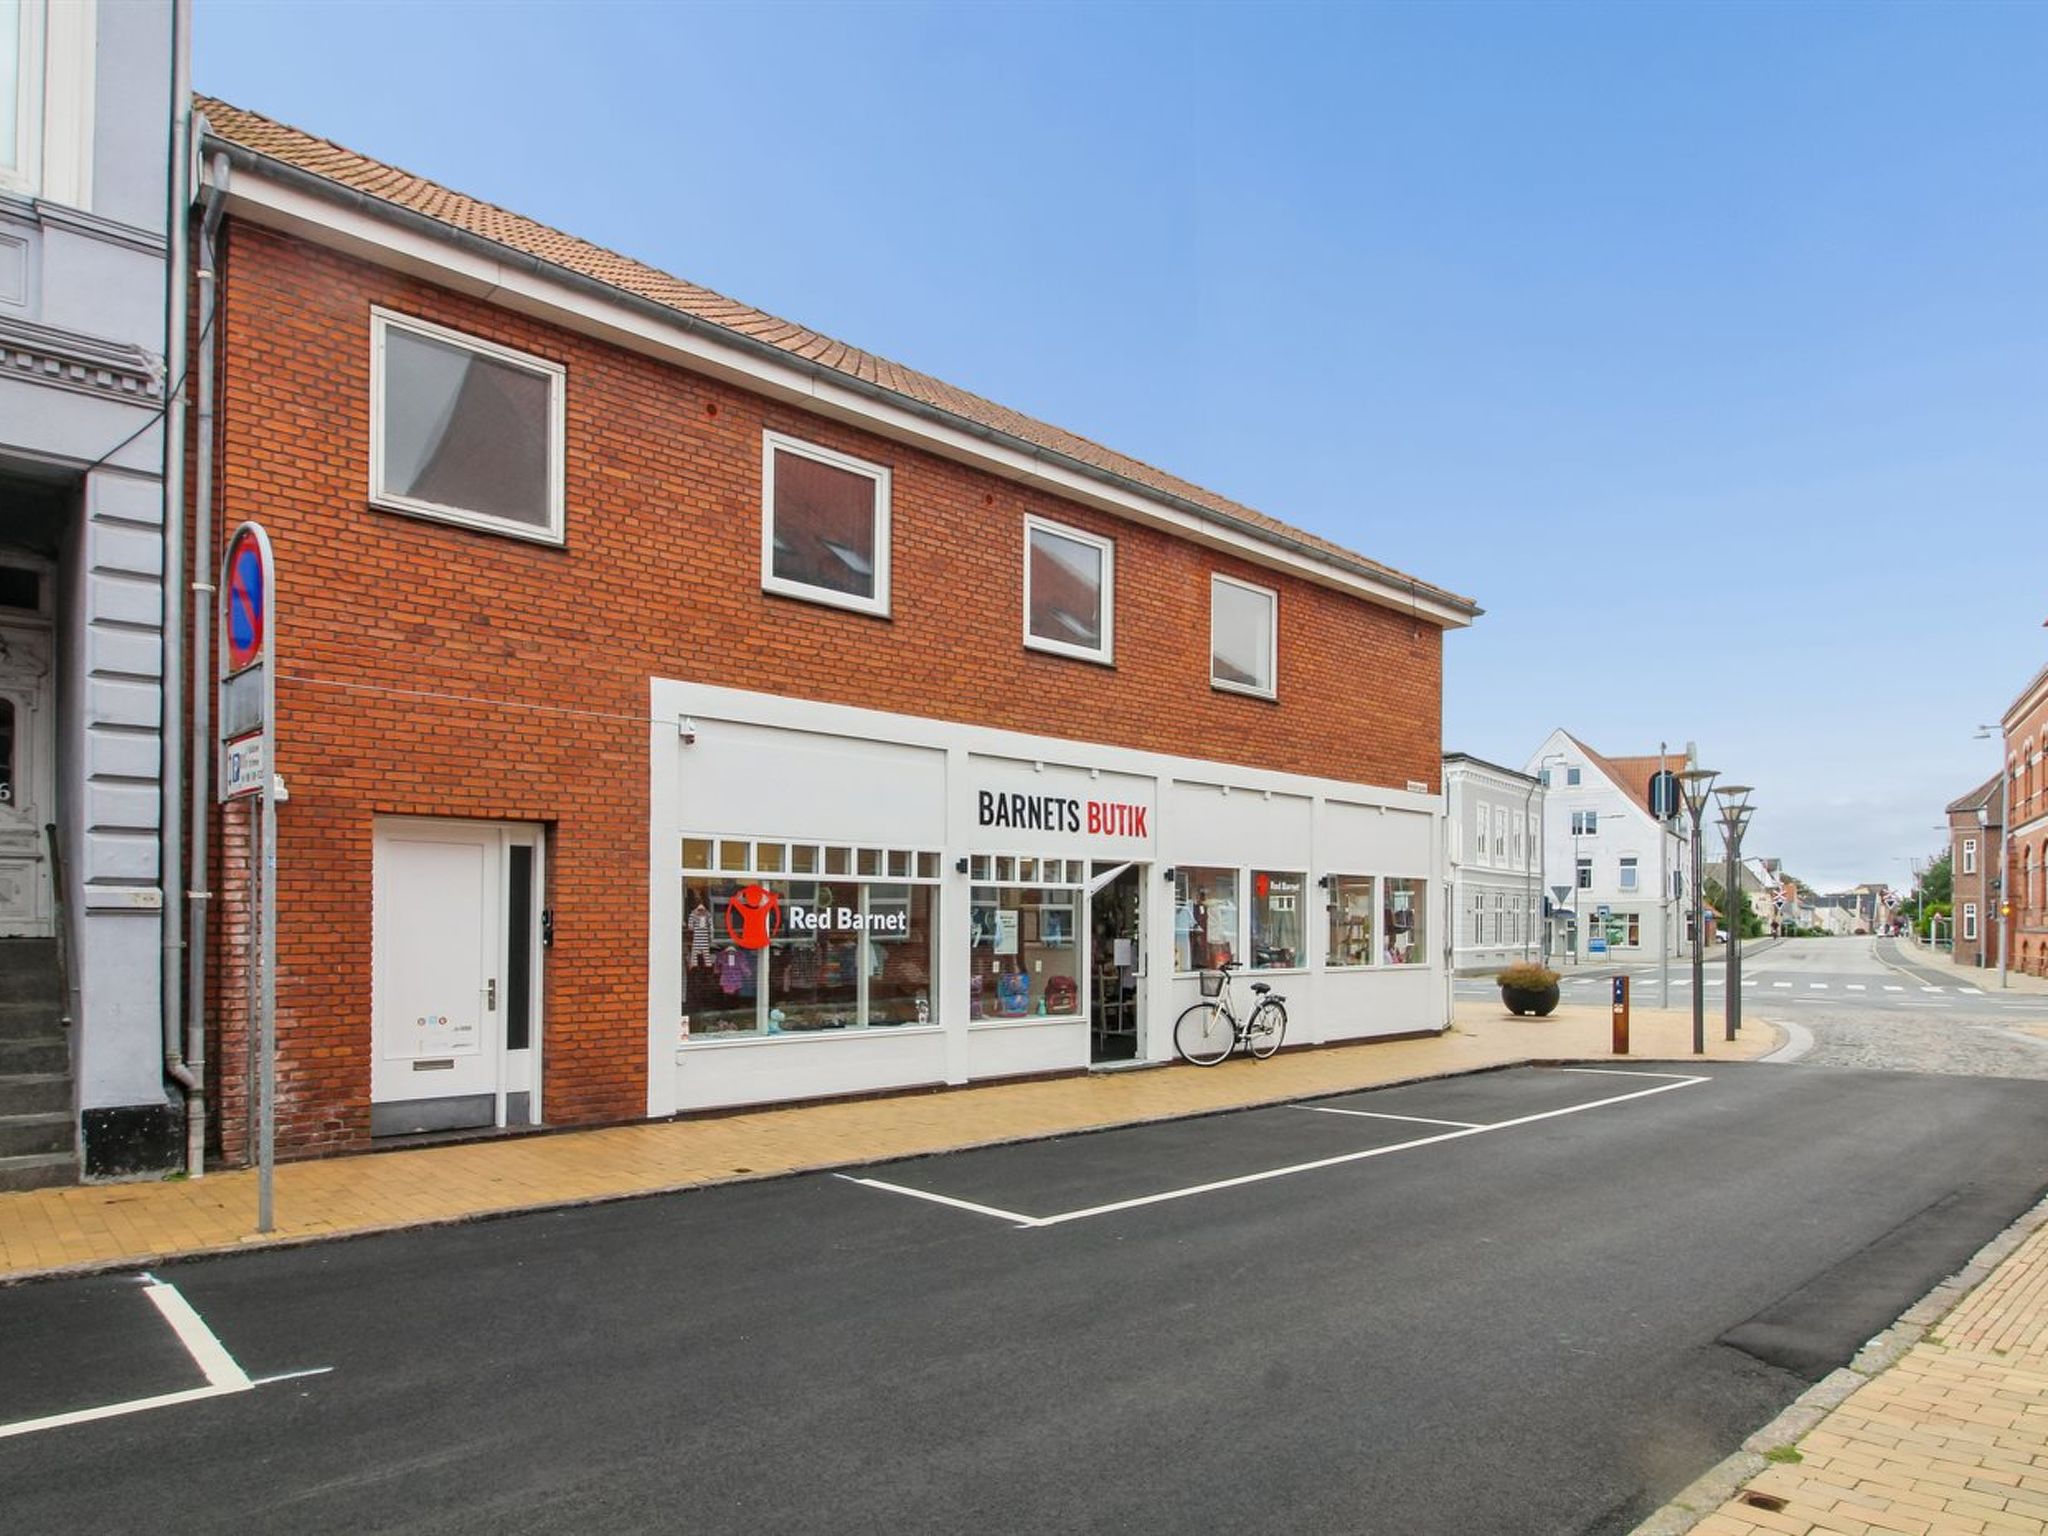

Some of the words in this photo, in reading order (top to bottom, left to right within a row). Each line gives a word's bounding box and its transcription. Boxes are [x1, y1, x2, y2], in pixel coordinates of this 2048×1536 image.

[978, 790, 1080, 833] BARNETS
[1087, 801, 1148, 838] BUTIK
[789, 906, 832, 930] Red
[837, 906, 906, 931] Barnet
